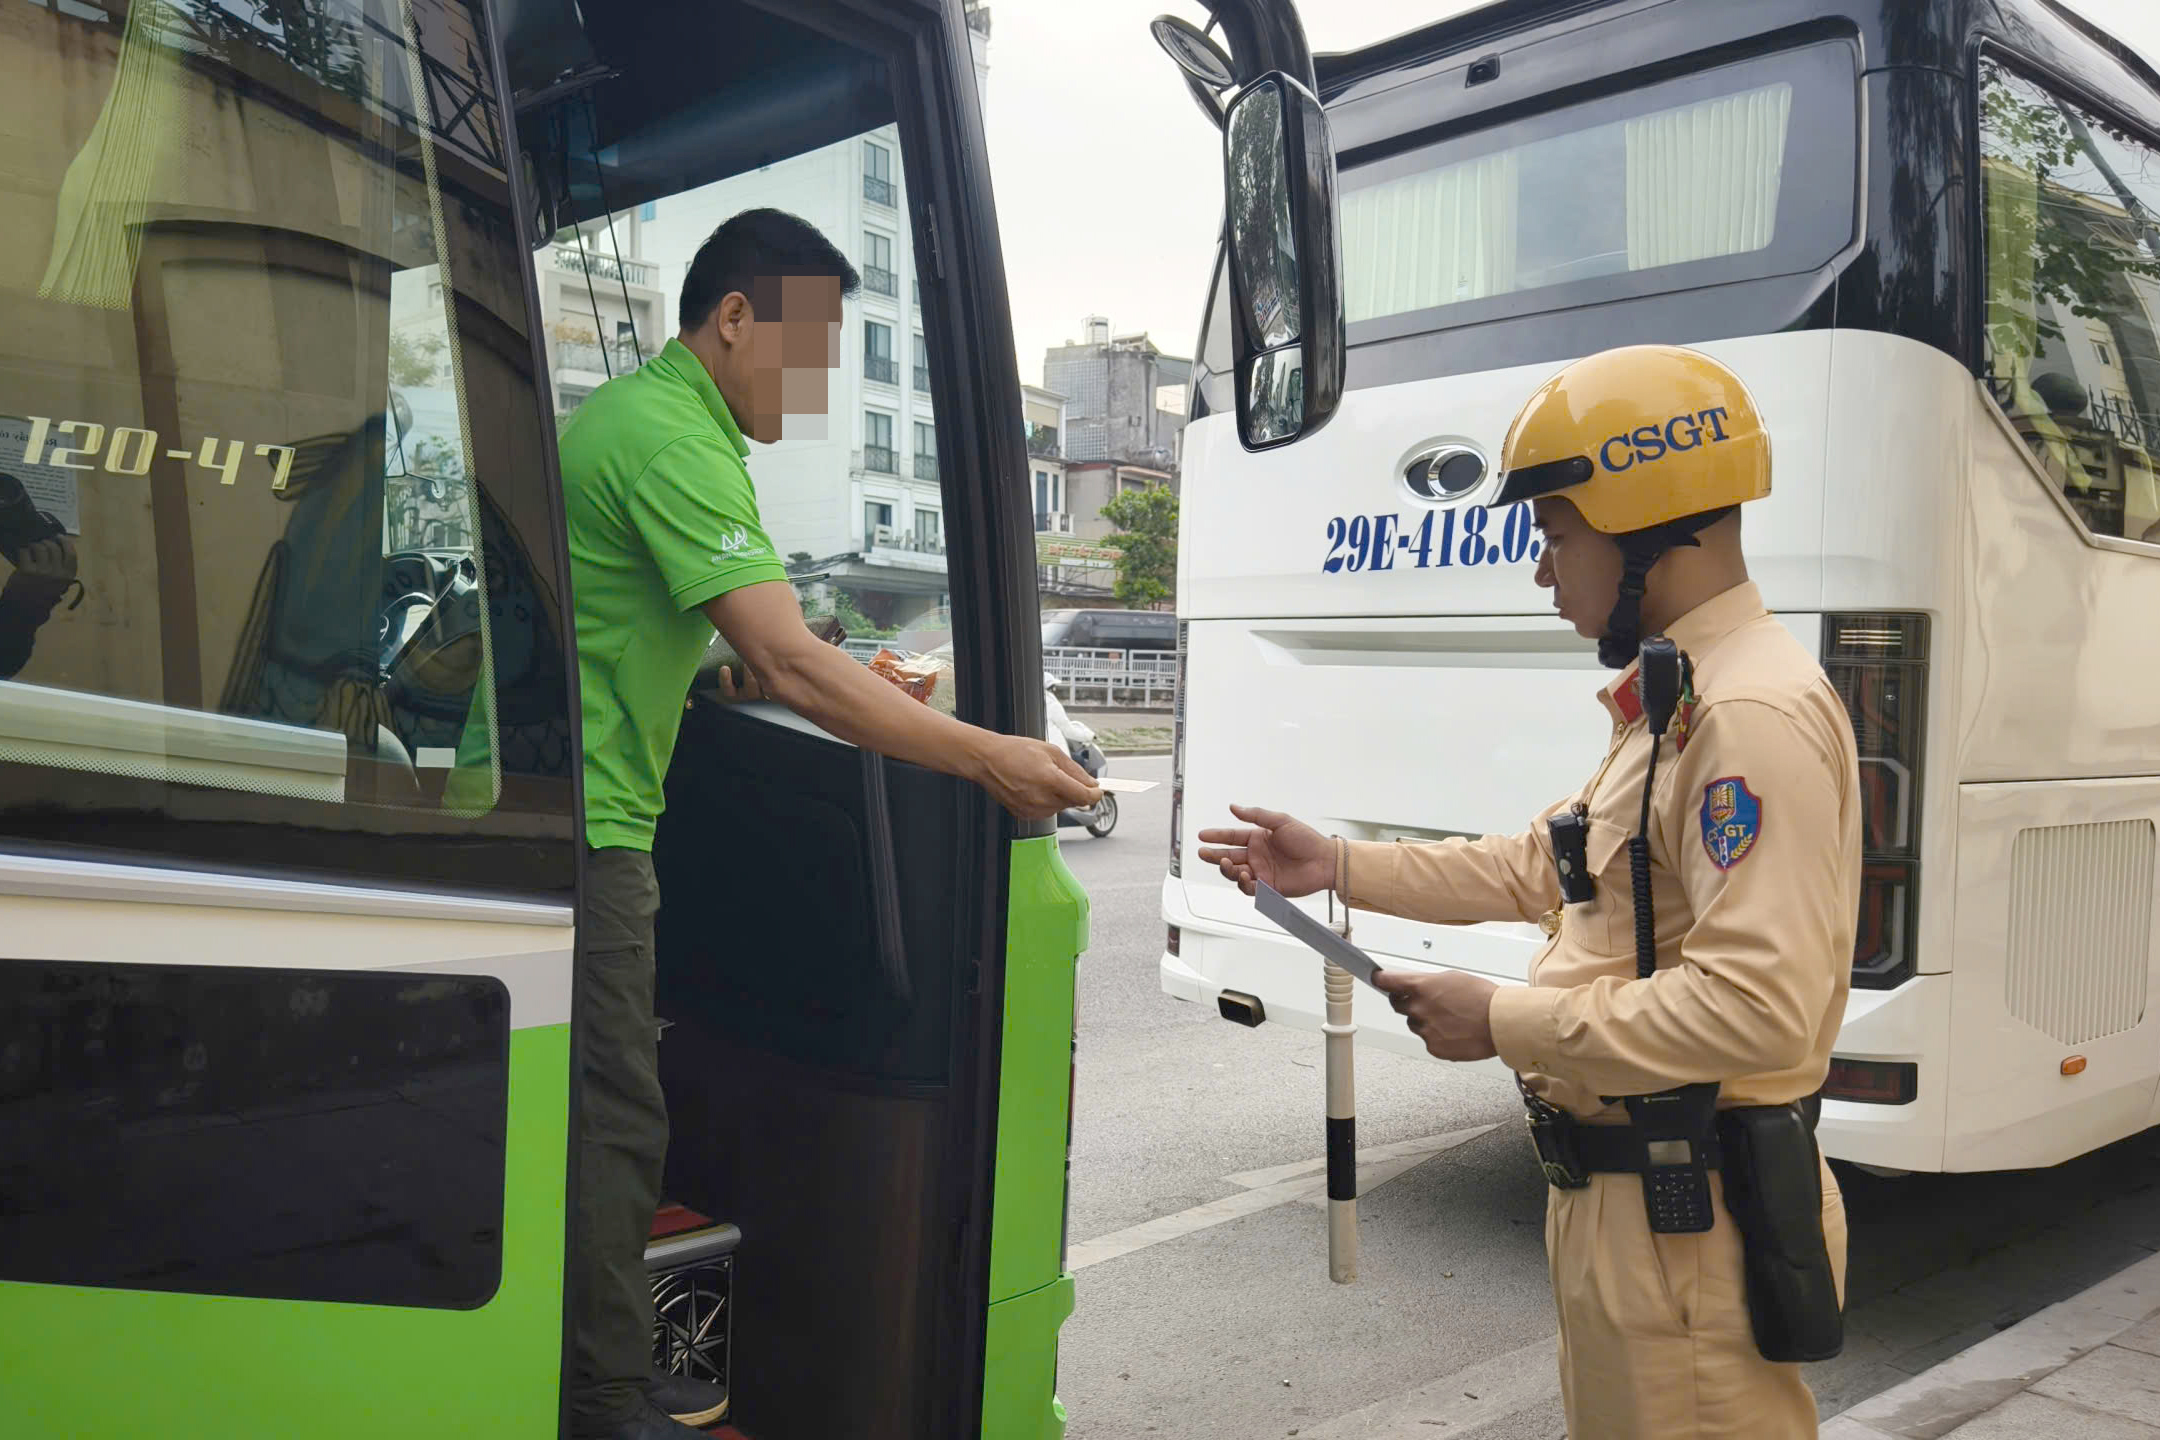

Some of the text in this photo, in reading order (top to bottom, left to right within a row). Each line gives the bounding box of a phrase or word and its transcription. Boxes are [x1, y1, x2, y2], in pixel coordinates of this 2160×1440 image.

[23, 415, 297, 490] 120-47
[1600, 406, 1730, 473] CSGT
[1322, 500, 1541, 575] 29E-418.0
[1724, 824, 1747, 837] GT
